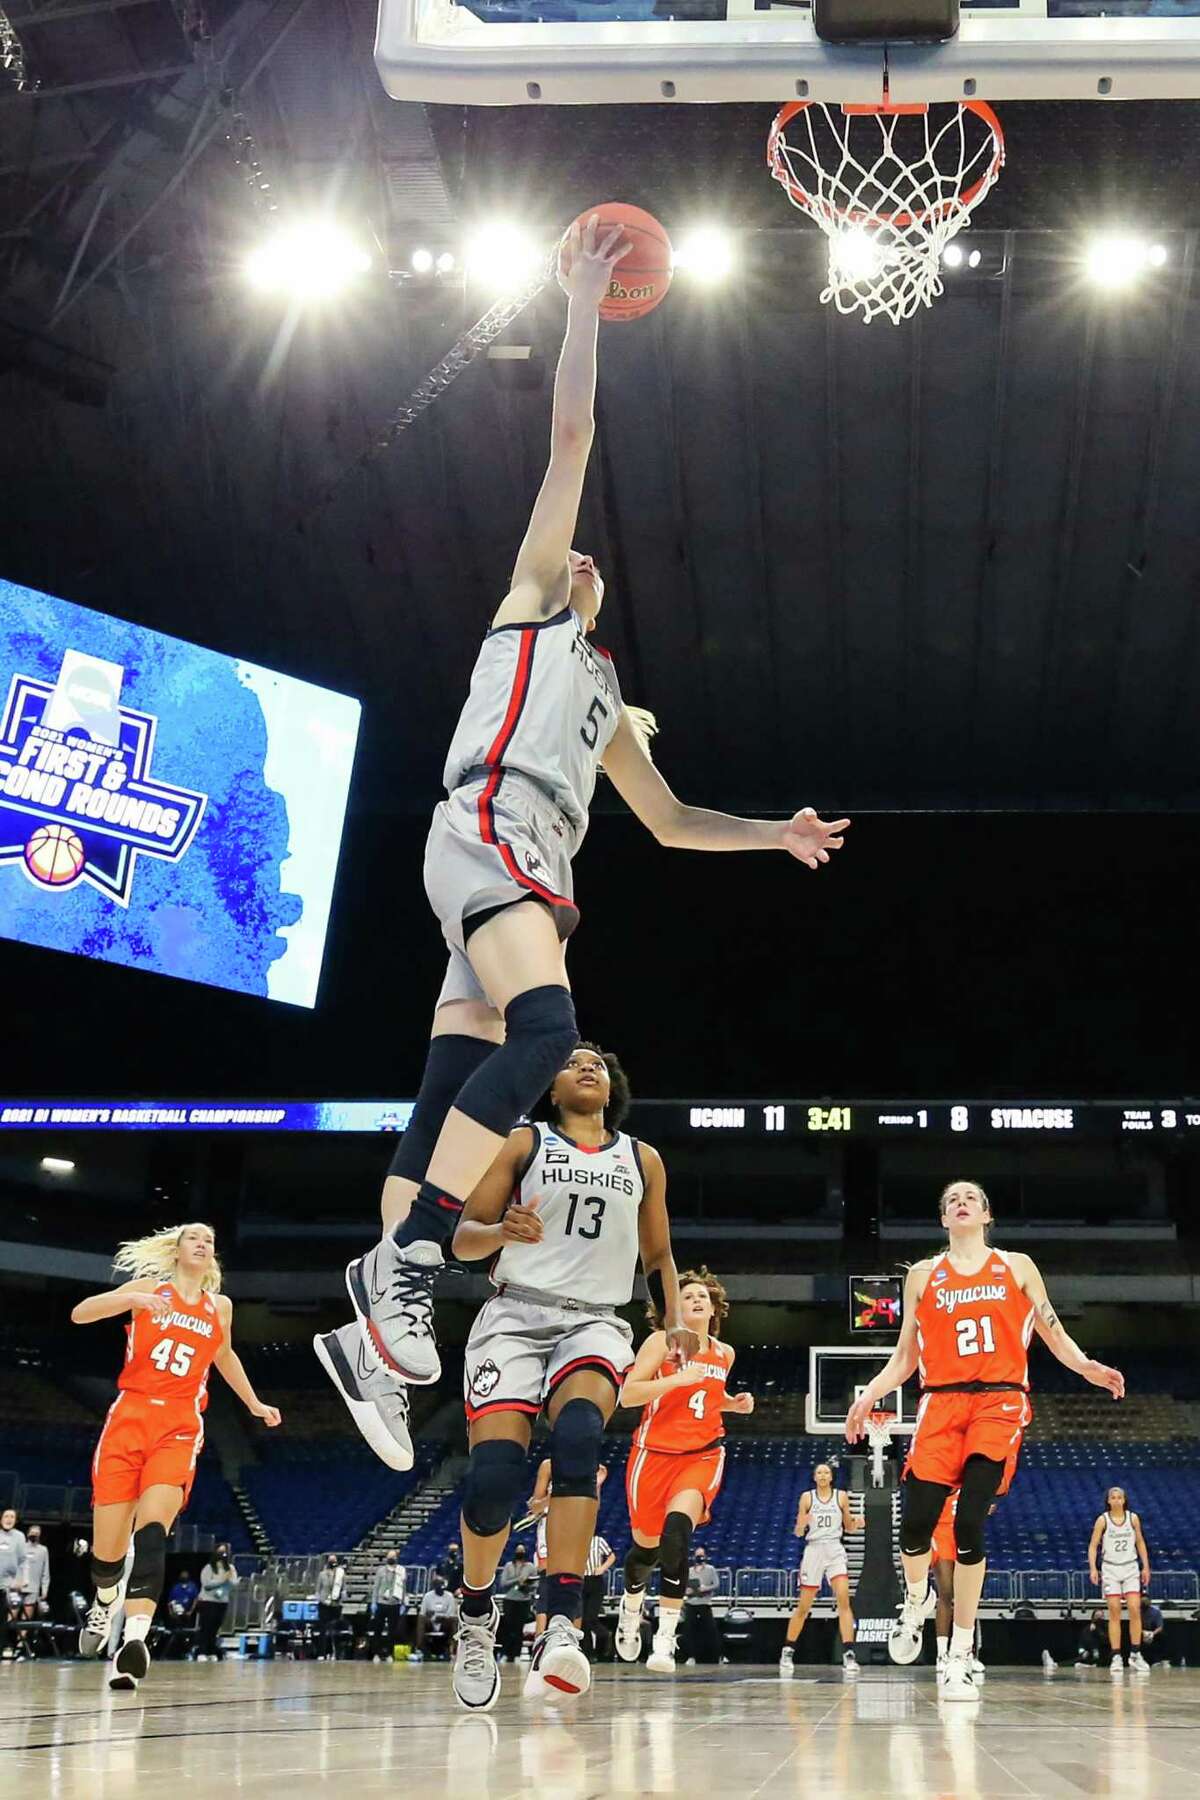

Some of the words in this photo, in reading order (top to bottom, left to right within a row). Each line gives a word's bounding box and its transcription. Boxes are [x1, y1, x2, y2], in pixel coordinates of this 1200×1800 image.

[605, 280, 655, 299] lson
[580, 696, 608, 752] 5
[66, 735, 124, 761] WOMEN'S
[18, 735, 107, 785] FIRST
[101, 760, 127, 792] &
[65, 782, 181, 839] ROUNDS
[50, 1108, 111, 1123] WOMEN'S
[111, 1109, 187, 1123] BASKETBALL
[188, 1109, 286, 1124] CHAMPIONSHIP
[690, 1108, 745, 1128] UCONN
[763, 1106, 785, 1131] 11
[807, 1107, 851, 1131] 3:41
[878, 1115, 914, 1125] PERIOD
[916, 1110, 928, 1128] 1
[950, 1106, 969, 1131] 8
[991, 1109, 1074, 1129] SYRACUSE
[1122, 1121, 1154, 1130] FOULS
[1123, 1110, 1151, 1120] TEAM
[1160, 1109, 1177, 1128] 3
[542, 1168, 634, 1196] HUSKIES
[565, 1193, 606, 1240] 13
[936, 1285, 1007, 1314] Syracuse
[955, 1315, 996, 1357] 21
[150, 1338, 196, 1377] 45
[688, 1389, 708, 1420] 4
[816, 1515, 832, 1528] 20
[1114, 1540, 1128, 1552] 22
